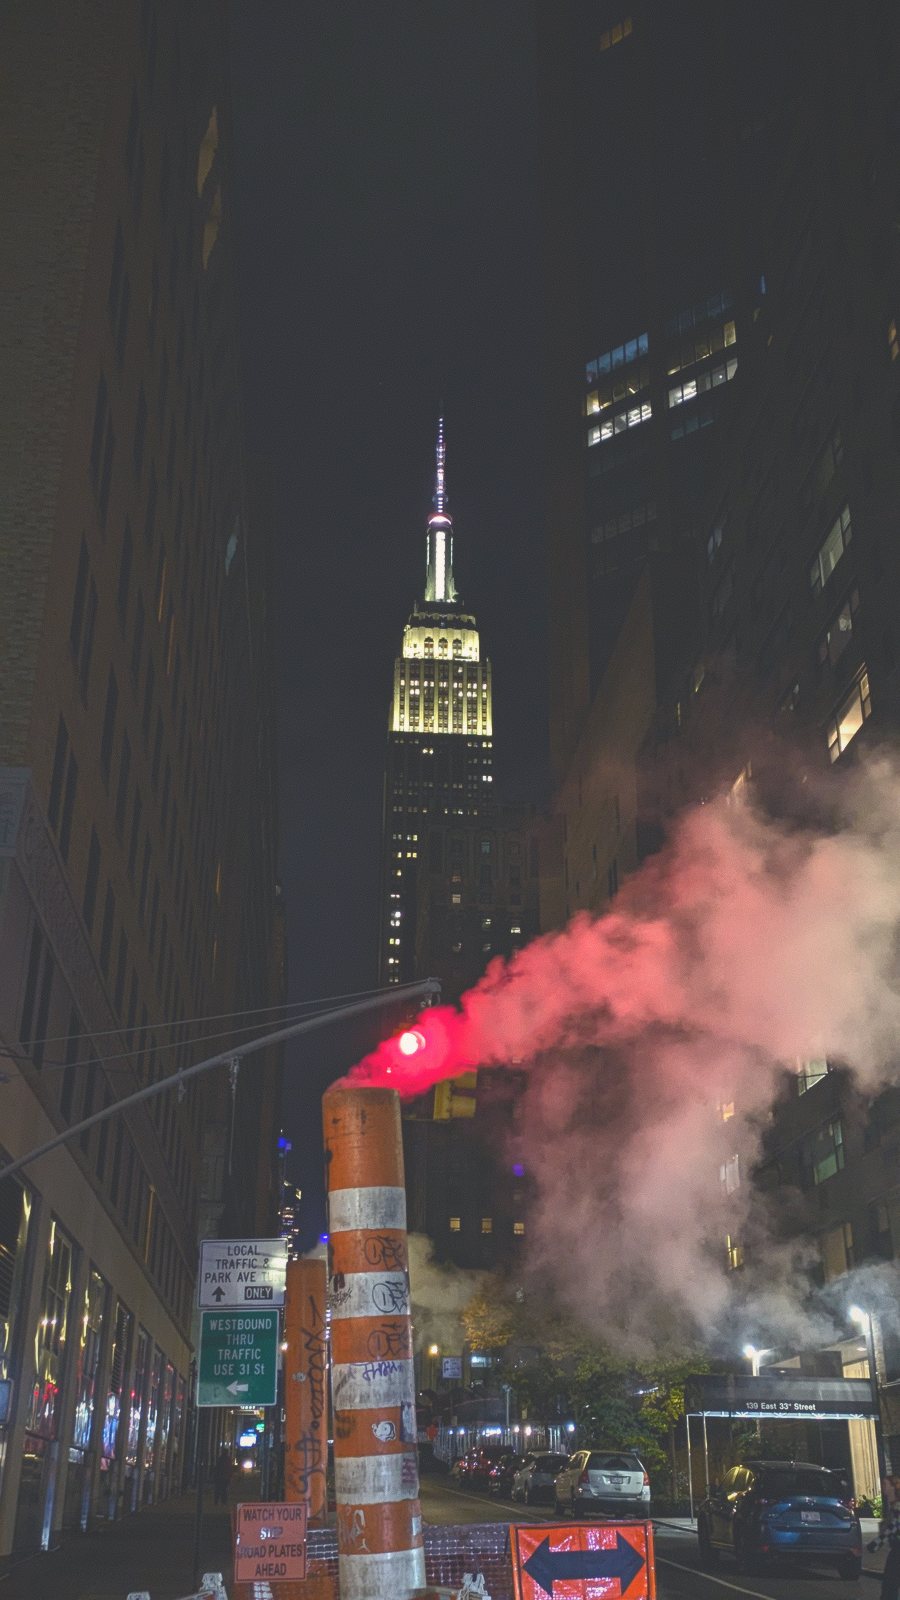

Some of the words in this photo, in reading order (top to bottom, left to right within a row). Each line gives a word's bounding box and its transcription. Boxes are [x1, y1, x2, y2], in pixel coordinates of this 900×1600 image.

[227, 1245, 259, 1256] LOCAL
[216, 1258, 257, 1270] TRAFFIC
[263, 1258, 269, 1269] &
[204, 1272, 231, 1283] PARK
[237, 1271, 256, 1282] AVE
[246, 1287, 272, 1299] ONLY
[209, 1318, 272, 1331] WESTBOUND
[226, 1334, 254, 1345] THRU
[218, 1348, 261, 1360] TRAFFIC
[214, 1364, 234, 1375] USE
[239, 1364, 250, 1375] 31
[254, 1363, 265, 1375] St
[746, 1402, 759, 1410] 139
[761, 1402, 777, 1410] East
[794, 1402, 816, 1411] Street
[244, 1508, 274, 1521] WATCH
[277, 1507, 302, 1520] YOUR
[240, 1546, 266, 1558] ROAD
[269, 1544, 302, 1558] PLATES
[255, 1563, 287, 1576] AHEAD
